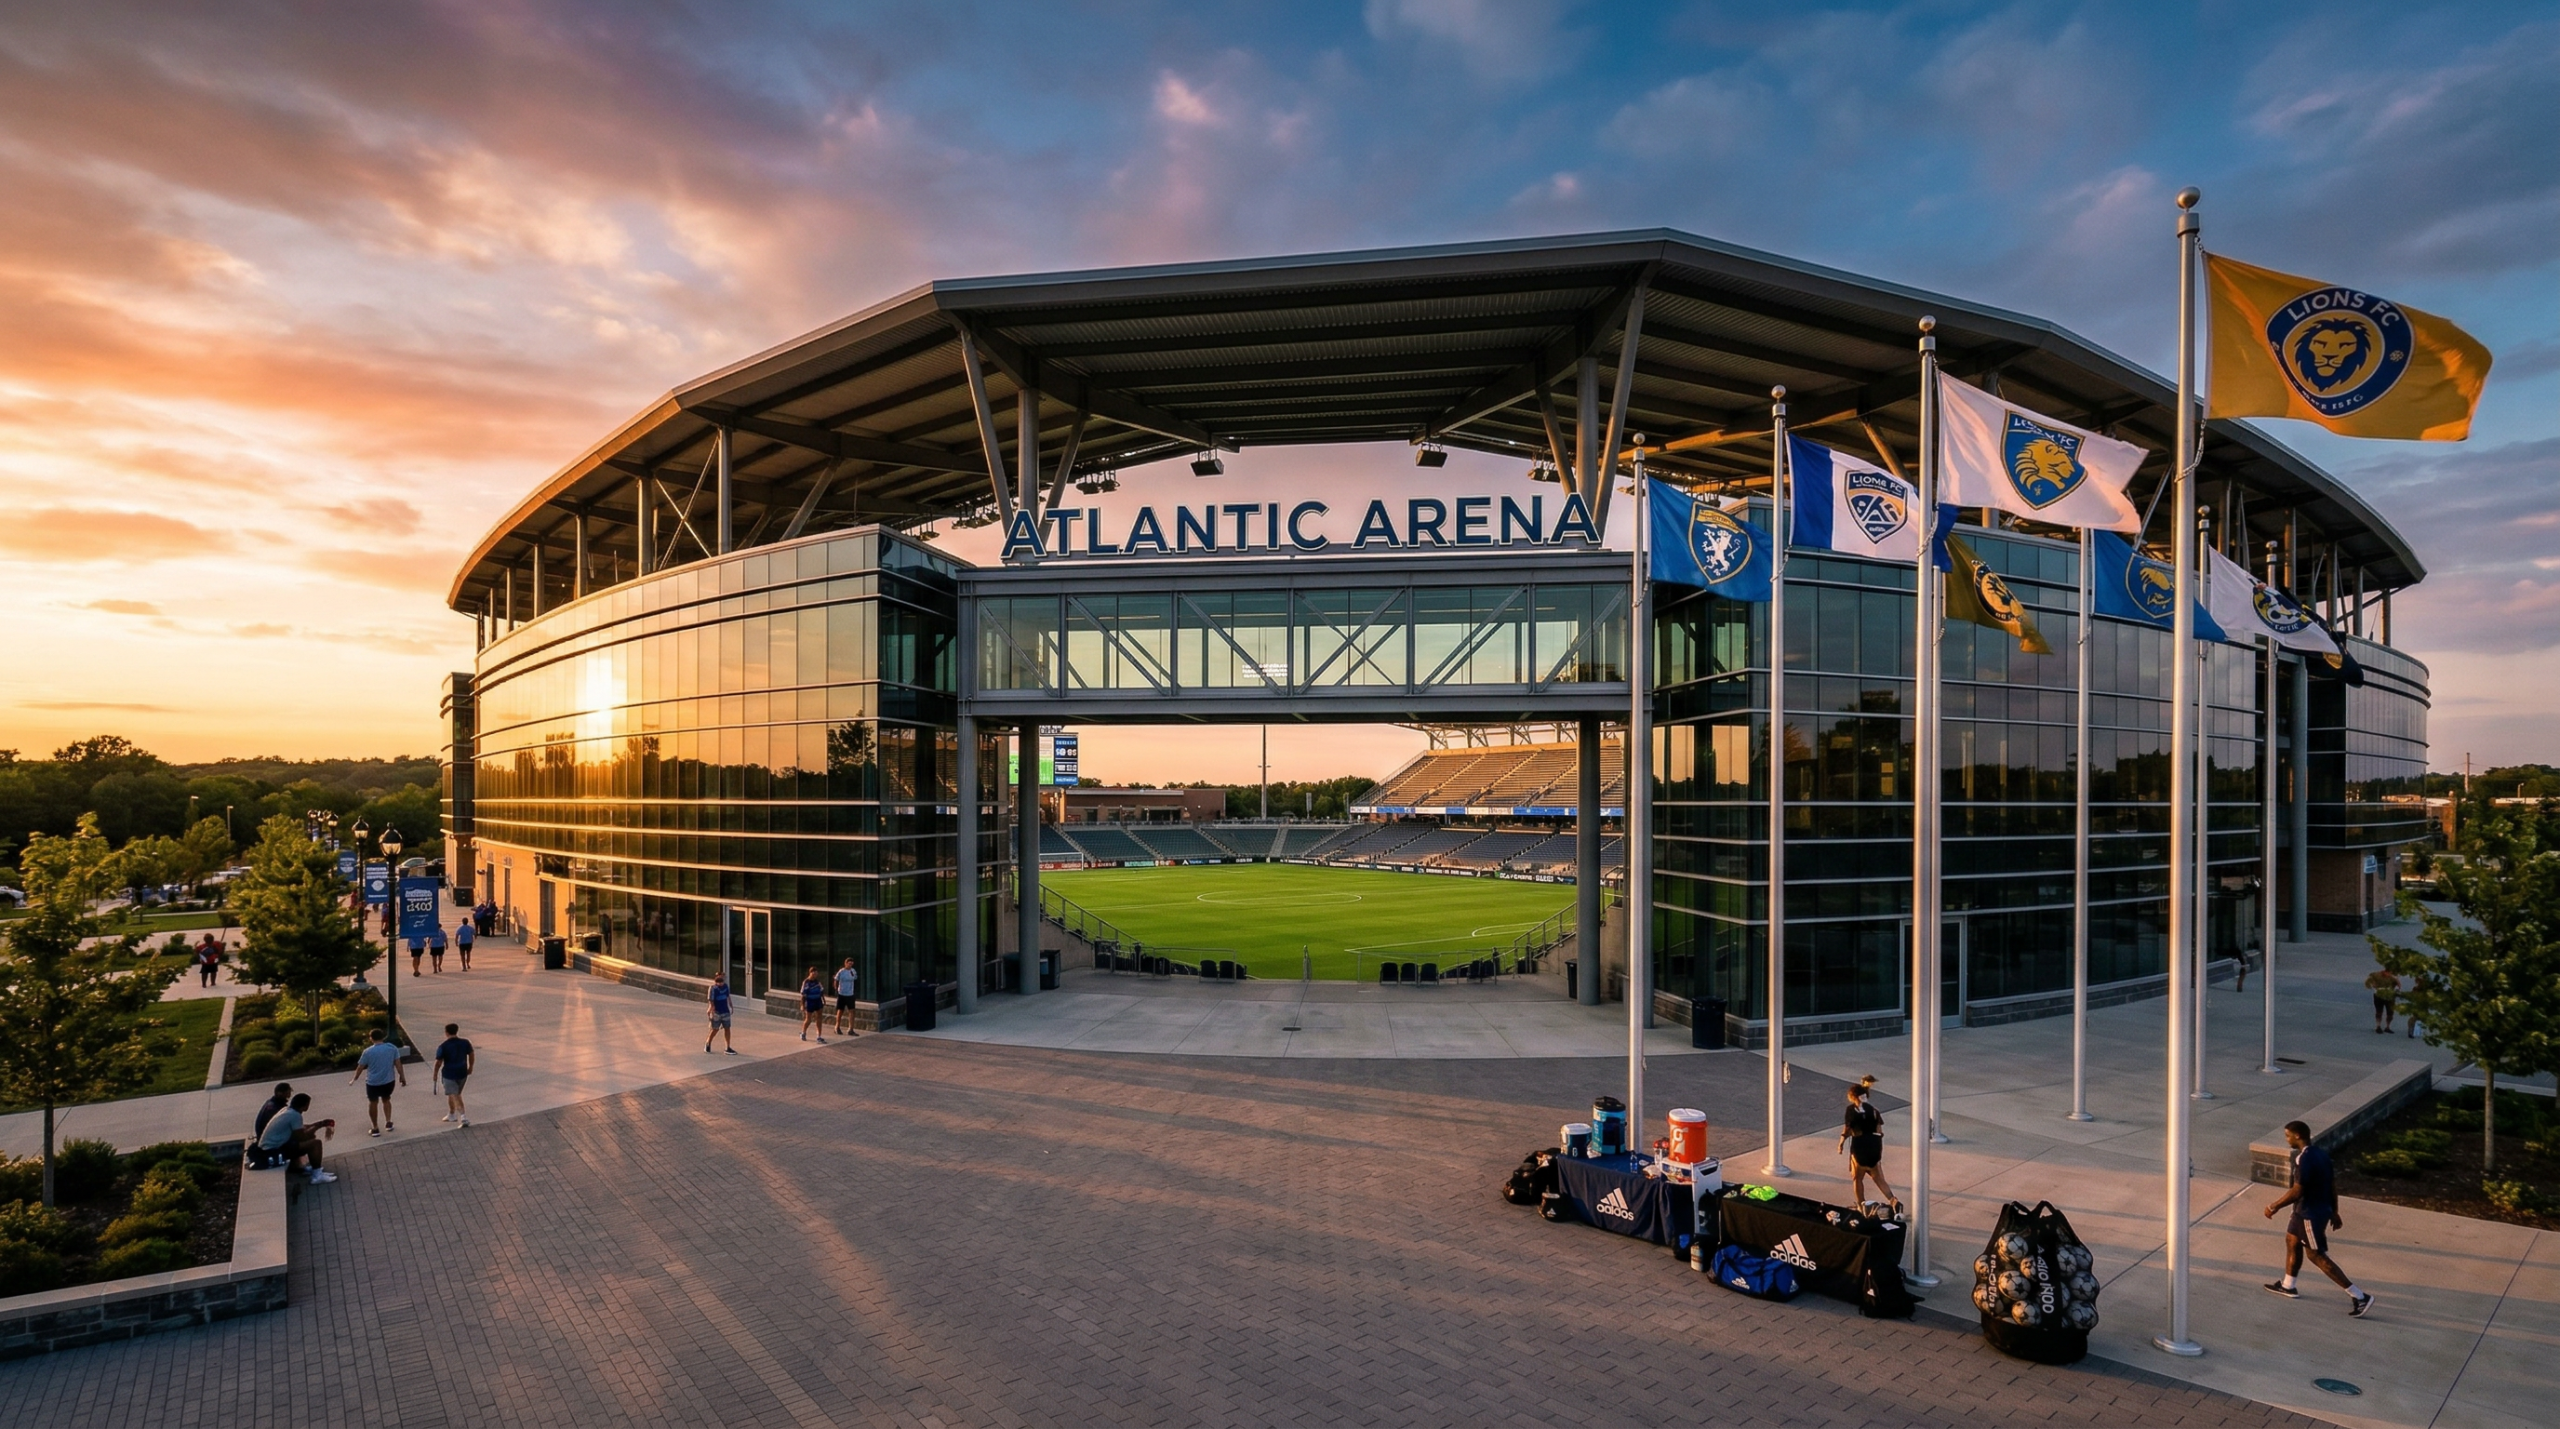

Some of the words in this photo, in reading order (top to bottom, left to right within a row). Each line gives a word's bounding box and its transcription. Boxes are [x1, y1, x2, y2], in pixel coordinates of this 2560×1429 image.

[2287, 291, 2366, 321] LIONS
[2370, 301, 2399, 327] FC
[1000, 501, 1329, 558] ATLANTIC
[1351, 493, 1602, 548] ARENA
